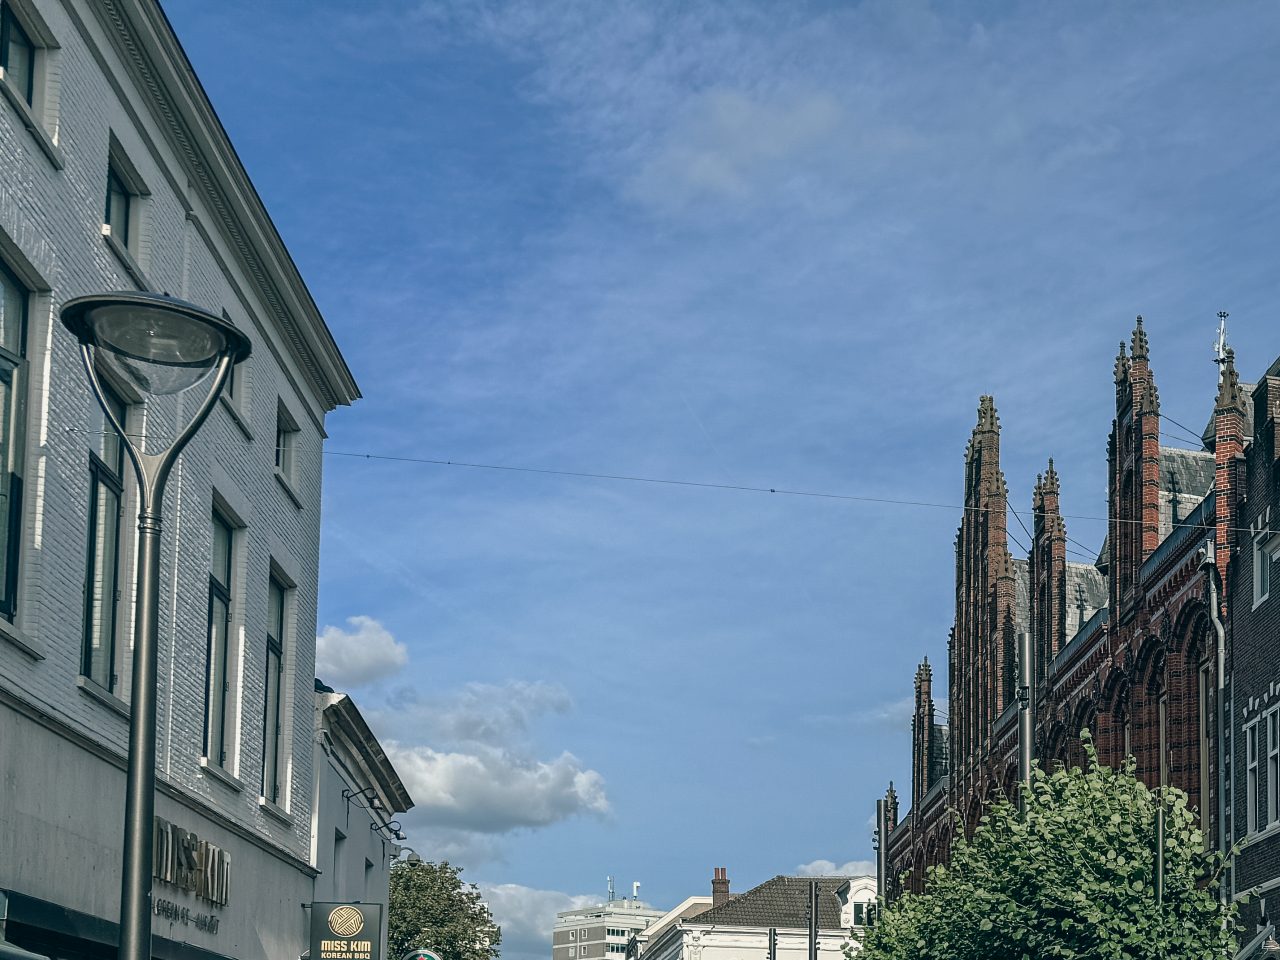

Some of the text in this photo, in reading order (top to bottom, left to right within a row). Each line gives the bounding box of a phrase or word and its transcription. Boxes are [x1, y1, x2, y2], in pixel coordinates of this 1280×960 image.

[321, 941, 371, 951] MISS KIM
[355, 952, 370, 960] BBQ
